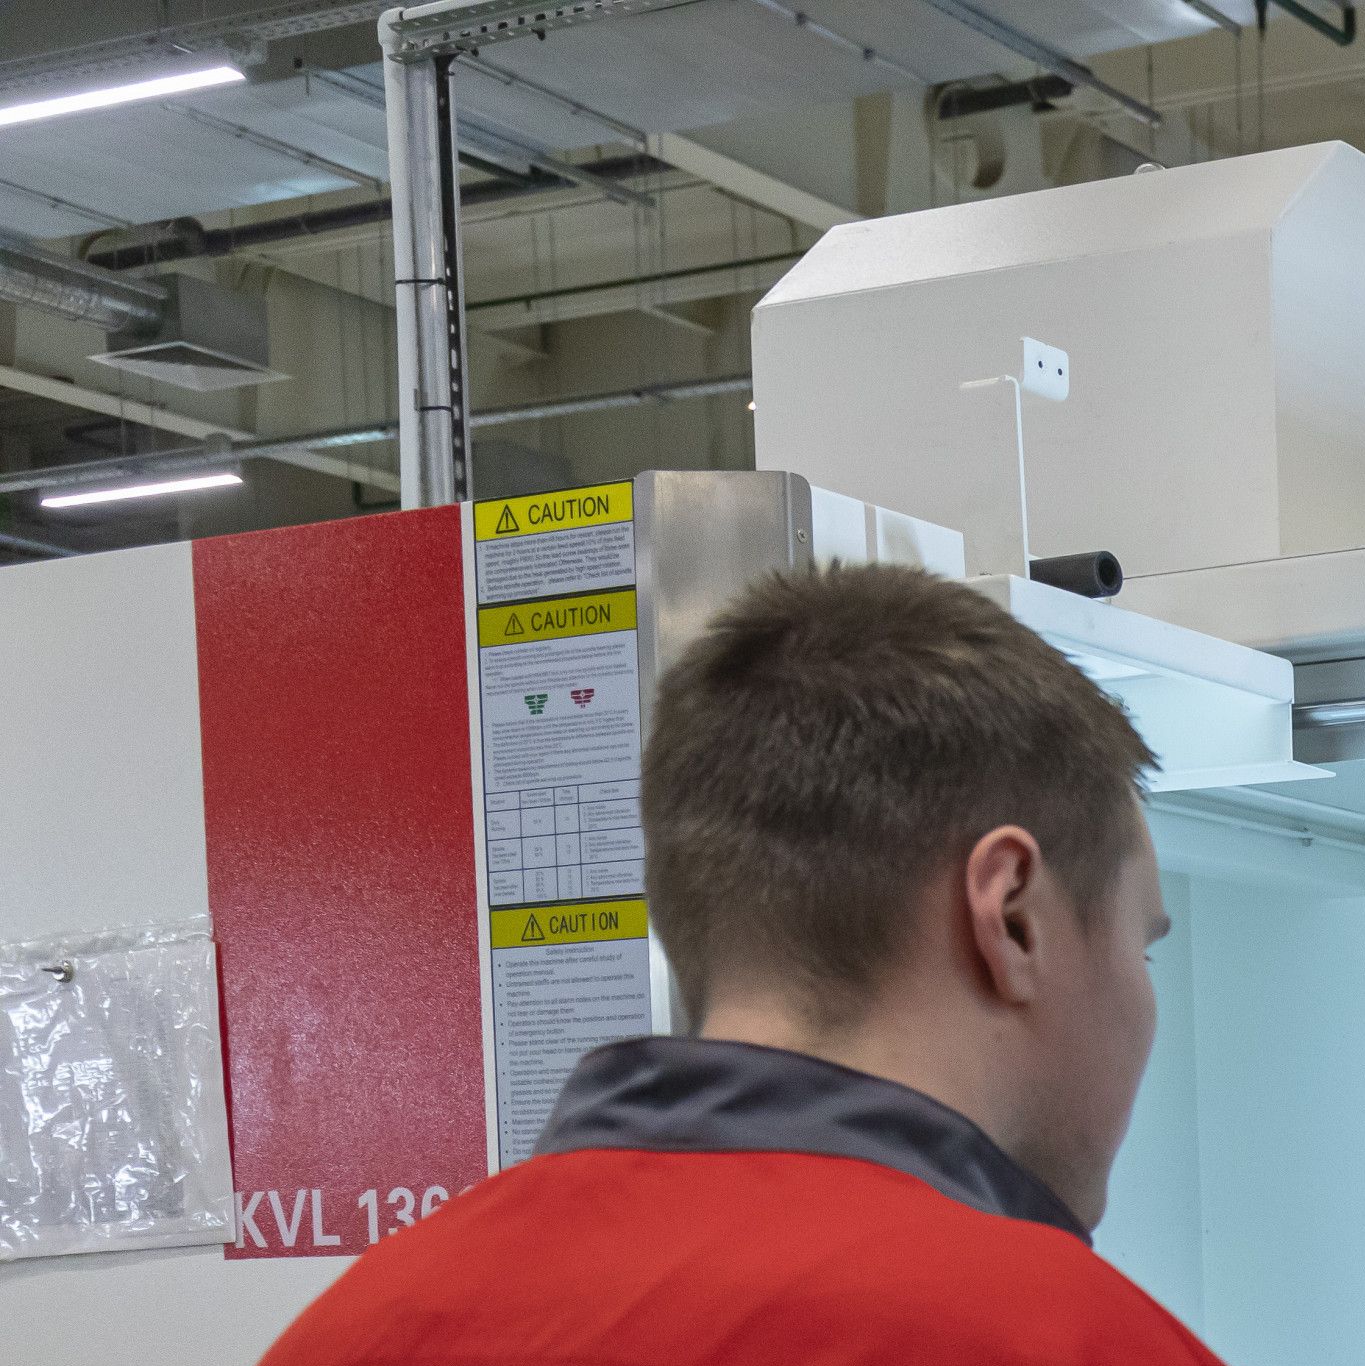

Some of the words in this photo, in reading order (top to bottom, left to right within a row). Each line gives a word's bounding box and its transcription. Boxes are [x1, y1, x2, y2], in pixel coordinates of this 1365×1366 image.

[528, 494, 609, 526] CAUTION
[531, 603, 610, 632] CAUTION
[549, 911, 619, 935] CAUTION
[235, 1188, 341, 1249] KVL
